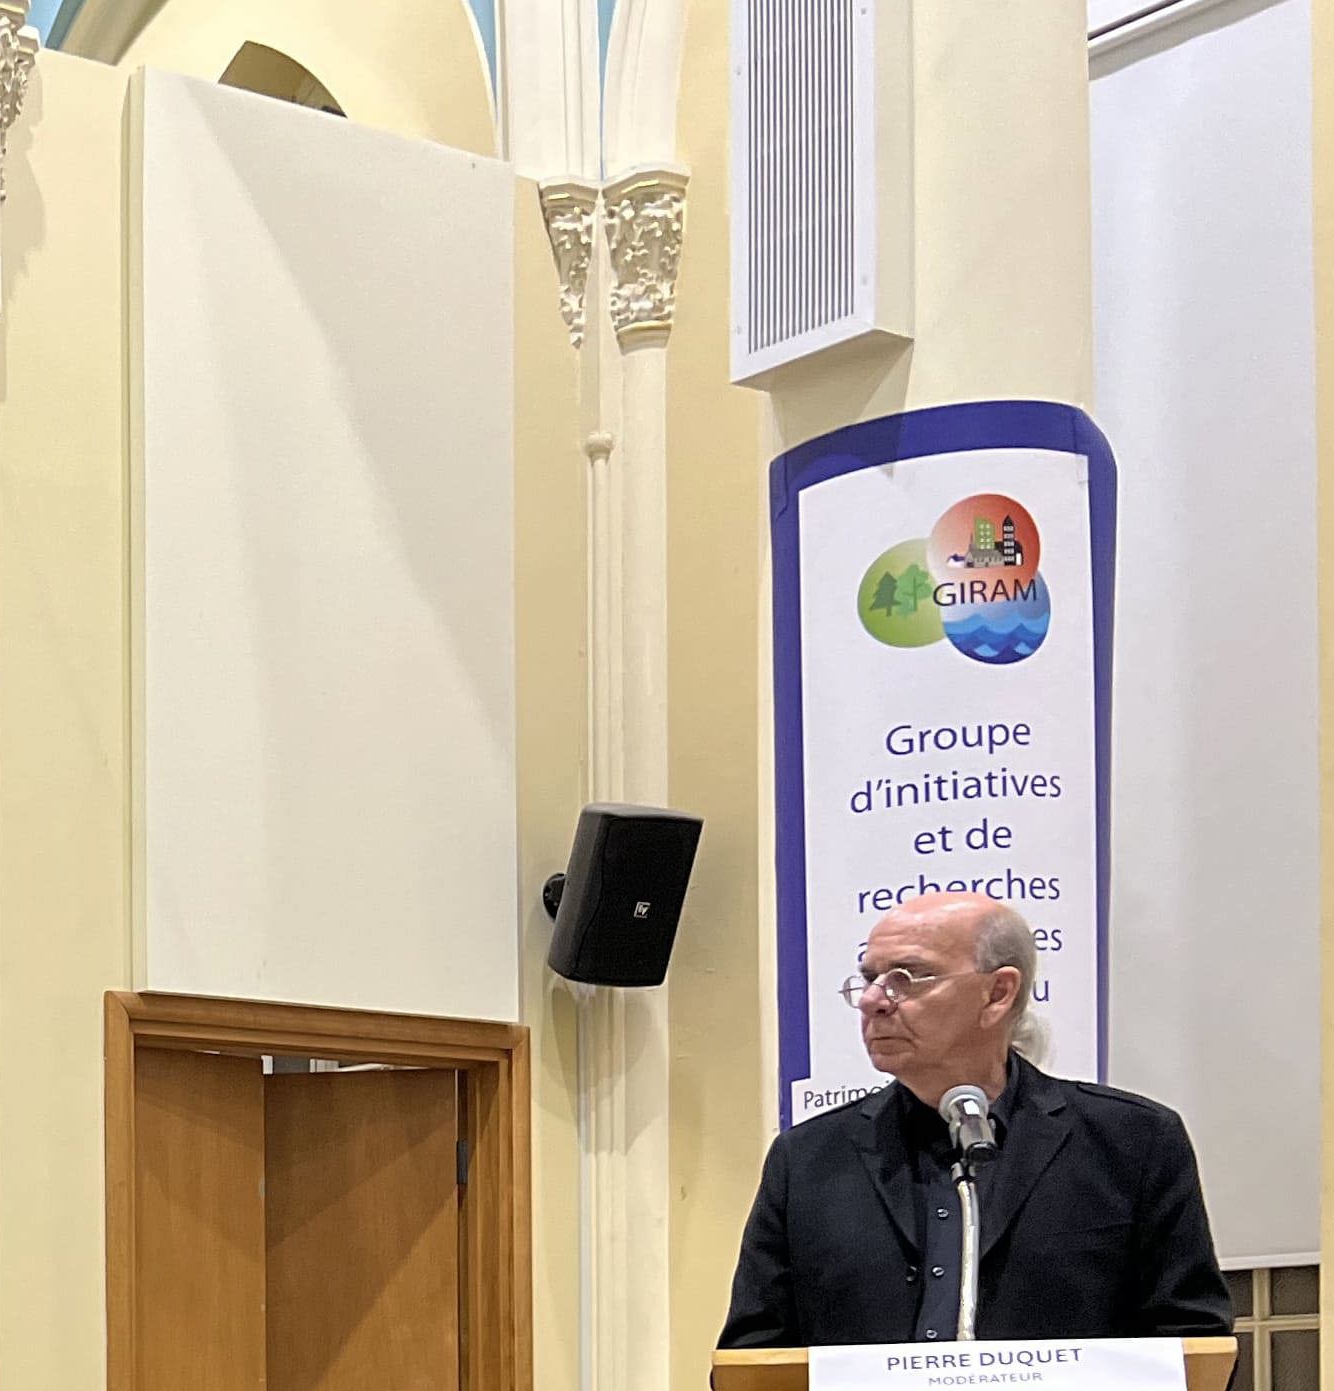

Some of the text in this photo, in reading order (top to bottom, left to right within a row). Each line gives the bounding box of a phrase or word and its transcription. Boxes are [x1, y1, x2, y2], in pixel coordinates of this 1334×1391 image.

[932, 578, 1038, 607] GIRAM
[885, 722, 1031, 756] Groupe
[913, 819, 1013, 854] et de
[803, 1081, 889, 1110] Patrim
[887, 1348, 1083, 1371] PIERRE DUQUET
[928, 1371, 1043, 1387] MODÉRATEUR
